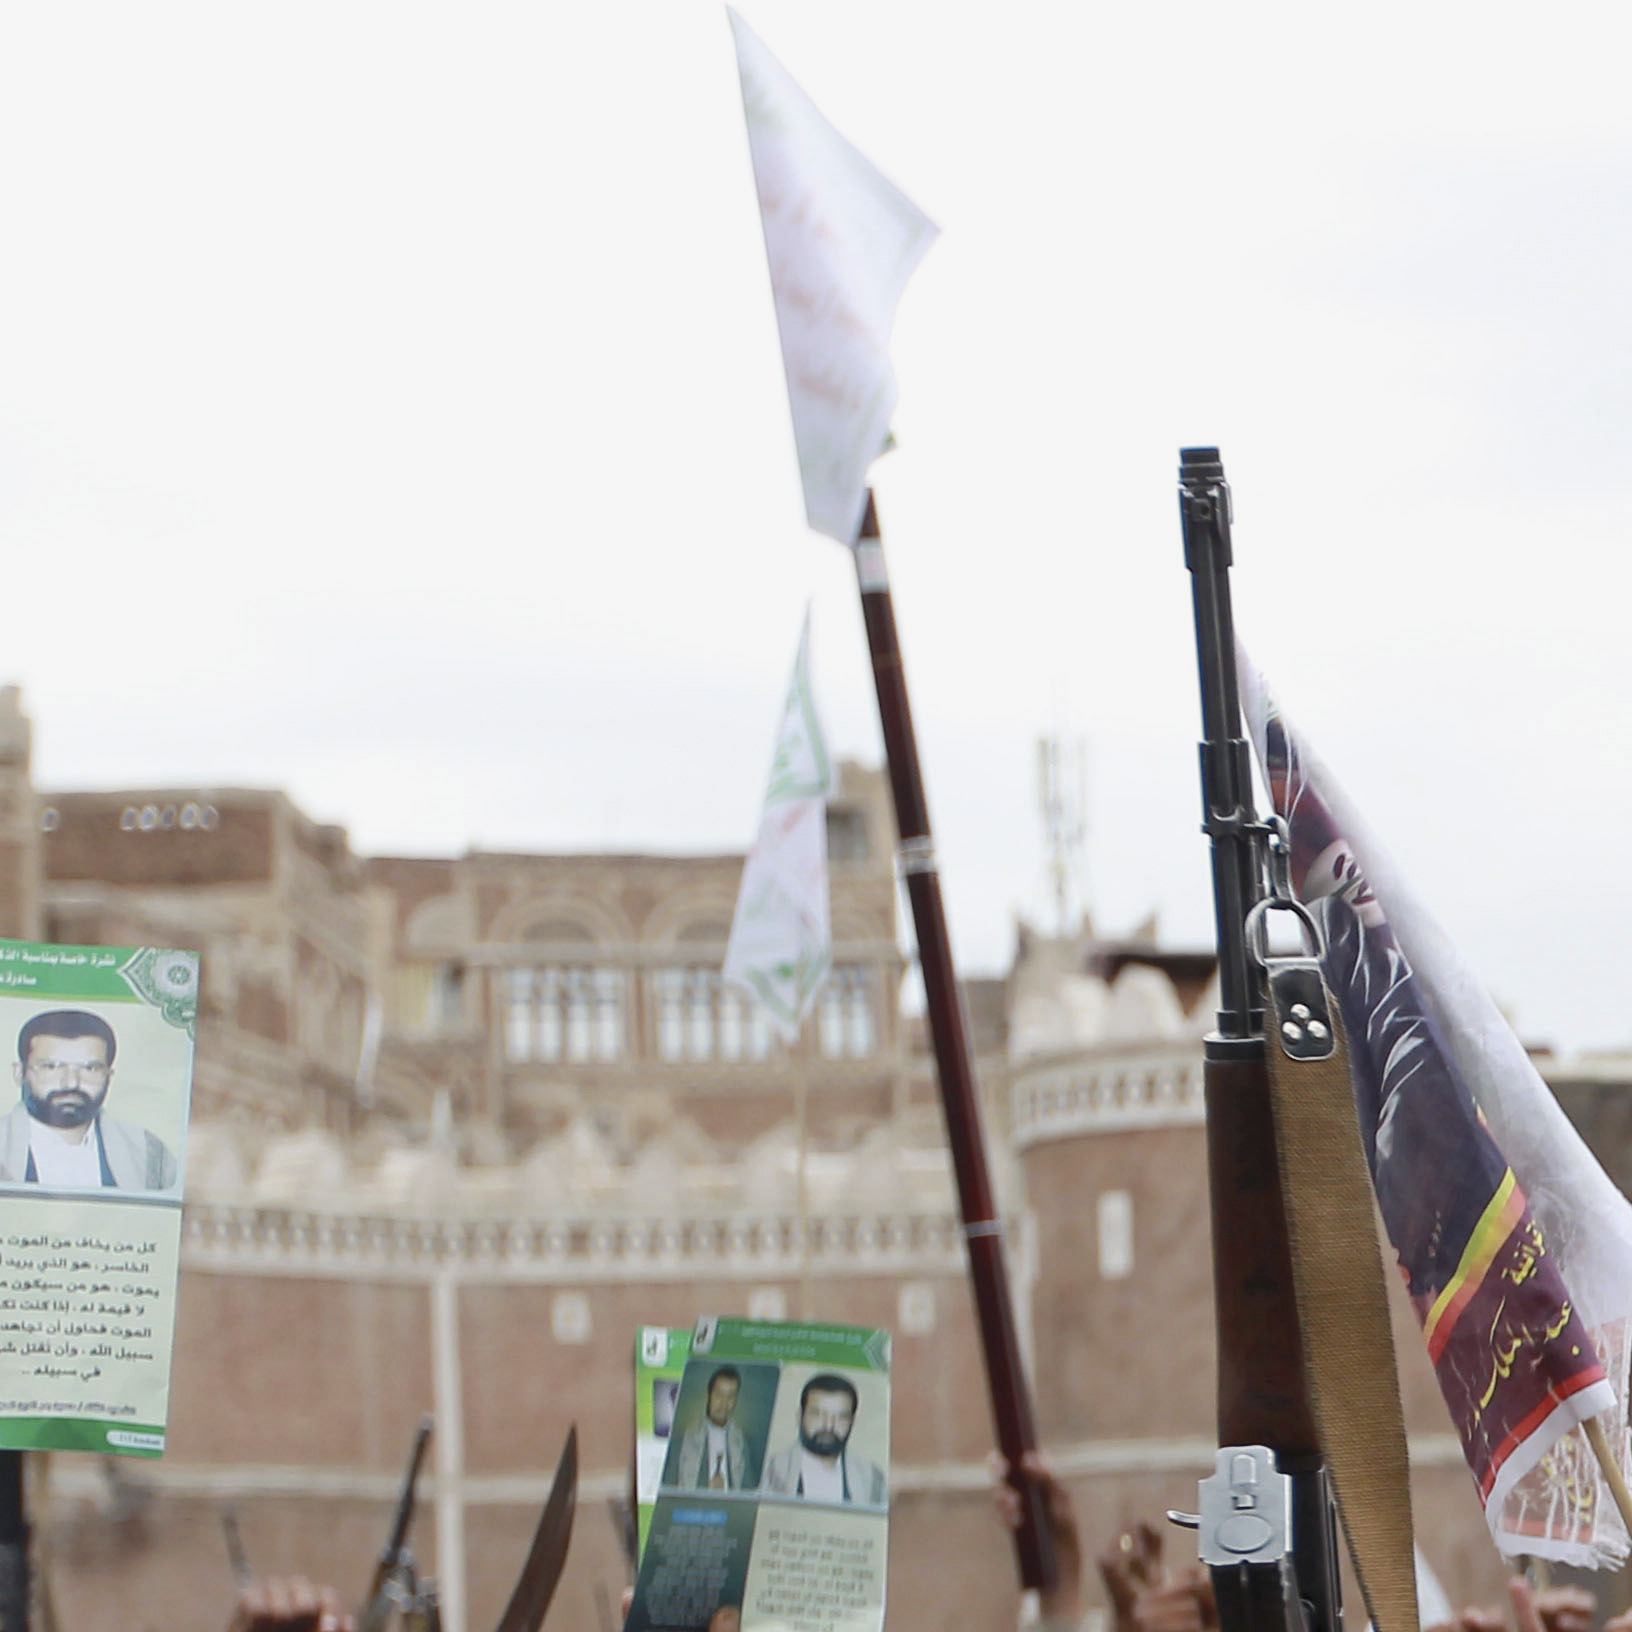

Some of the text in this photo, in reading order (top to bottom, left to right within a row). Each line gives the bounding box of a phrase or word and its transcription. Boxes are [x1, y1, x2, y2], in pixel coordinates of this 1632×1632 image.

[7, 1235, 157, 1255] كل من يخاف من الموت
[37, 1258, 67, 1273] الذي
[70, 1262, 91, 1272] هو
[11, 1278, 63, 1291] سيكون
[66, 1282, 87, 1293] من
[89, 1282, 111, 1294] هو
[121, 1283, 160, 1299] يموت
[19, 1299, 50, 1312] كنت
[53, 1300, 70, 1315] إذا
[80, 1301, 95, 1312] له
[98, 1302, 132, 1317] قيمة
[135, 1304, 145, 1316] لا
[46, 1319, 61, 1334] أن
[64, 1322, 107, 1337] فحاول
[110, 1327, 152, 1340] الموت
[54, 1342, 79, 1357] وأن
[89, 1343, 112, 1356] الله
[115, 1347, 153, 1362] سبيل
[34, 1364, 101, 1382] في سبيله
